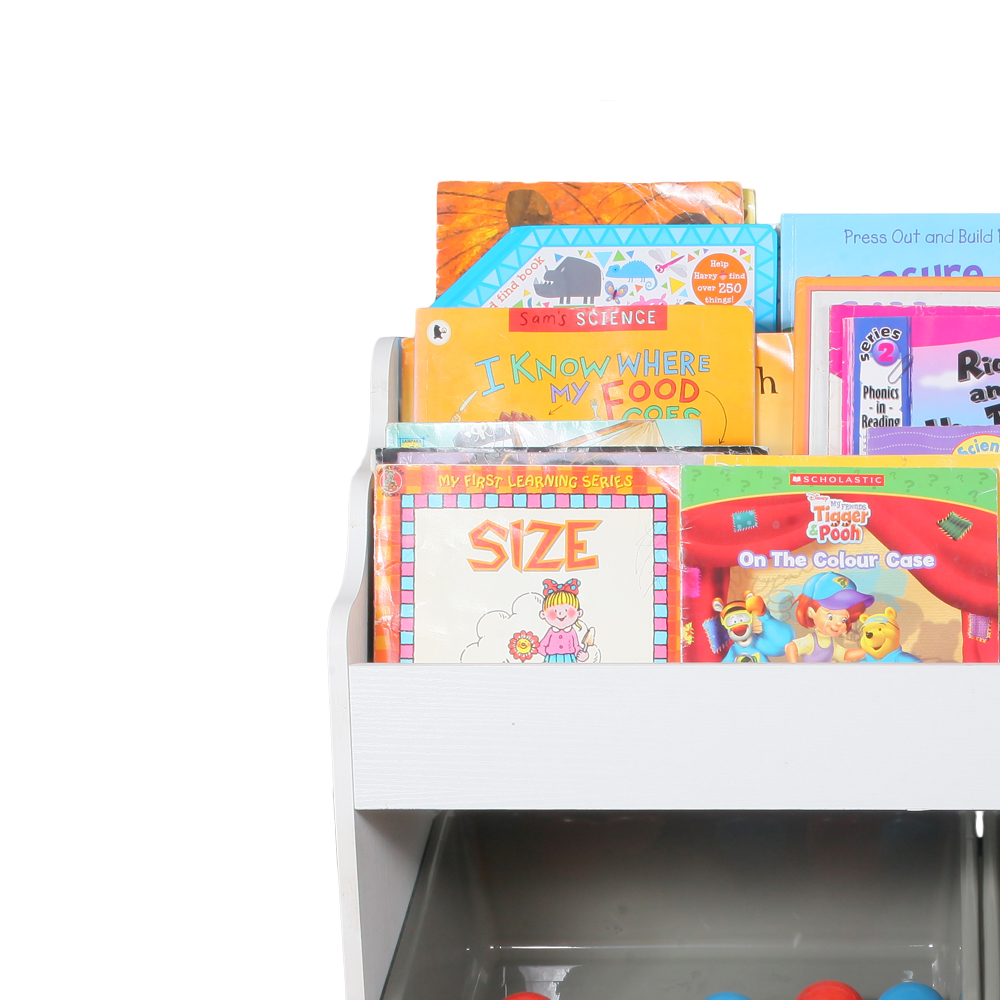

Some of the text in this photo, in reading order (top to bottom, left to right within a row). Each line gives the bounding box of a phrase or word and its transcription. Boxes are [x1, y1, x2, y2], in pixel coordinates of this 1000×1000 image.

[844, 229, 887, 244] Press
[892, 229, 920, 244] Out
[925, 229, 954, 244] and
[959, 229, 993, 244] Build
[710, 259, 730, 269] Help
[497, 256, 545, 303] find book
[694, 271, 746, 281] Harry find
[718, 282, 742, 294] 250
[704, 295, 735, 304] things!
[520, 309, 657, 327] Sam's SCIENCE
[860, 326, 903, 362] series
[877, 342, 895, 362] 2
[475, 349, 711, 396] I KNOW WHERE
[550, 378, 700, 420] MY FOOD
[862, 385, 900, 400] Phonics
[861, 414, 901, 428] Reading
[438, 474, 634, 489] MY FIRST LEARNING SERIES
[803, 475, 882, 484] SCHOLASTIC
[813, 504, 869, 527] Tigger
[809, 524, 860, 541] & Pooh
[466, 518, 604, 573] SIZE
[738, 550, 936, 569] On The Colour Case
